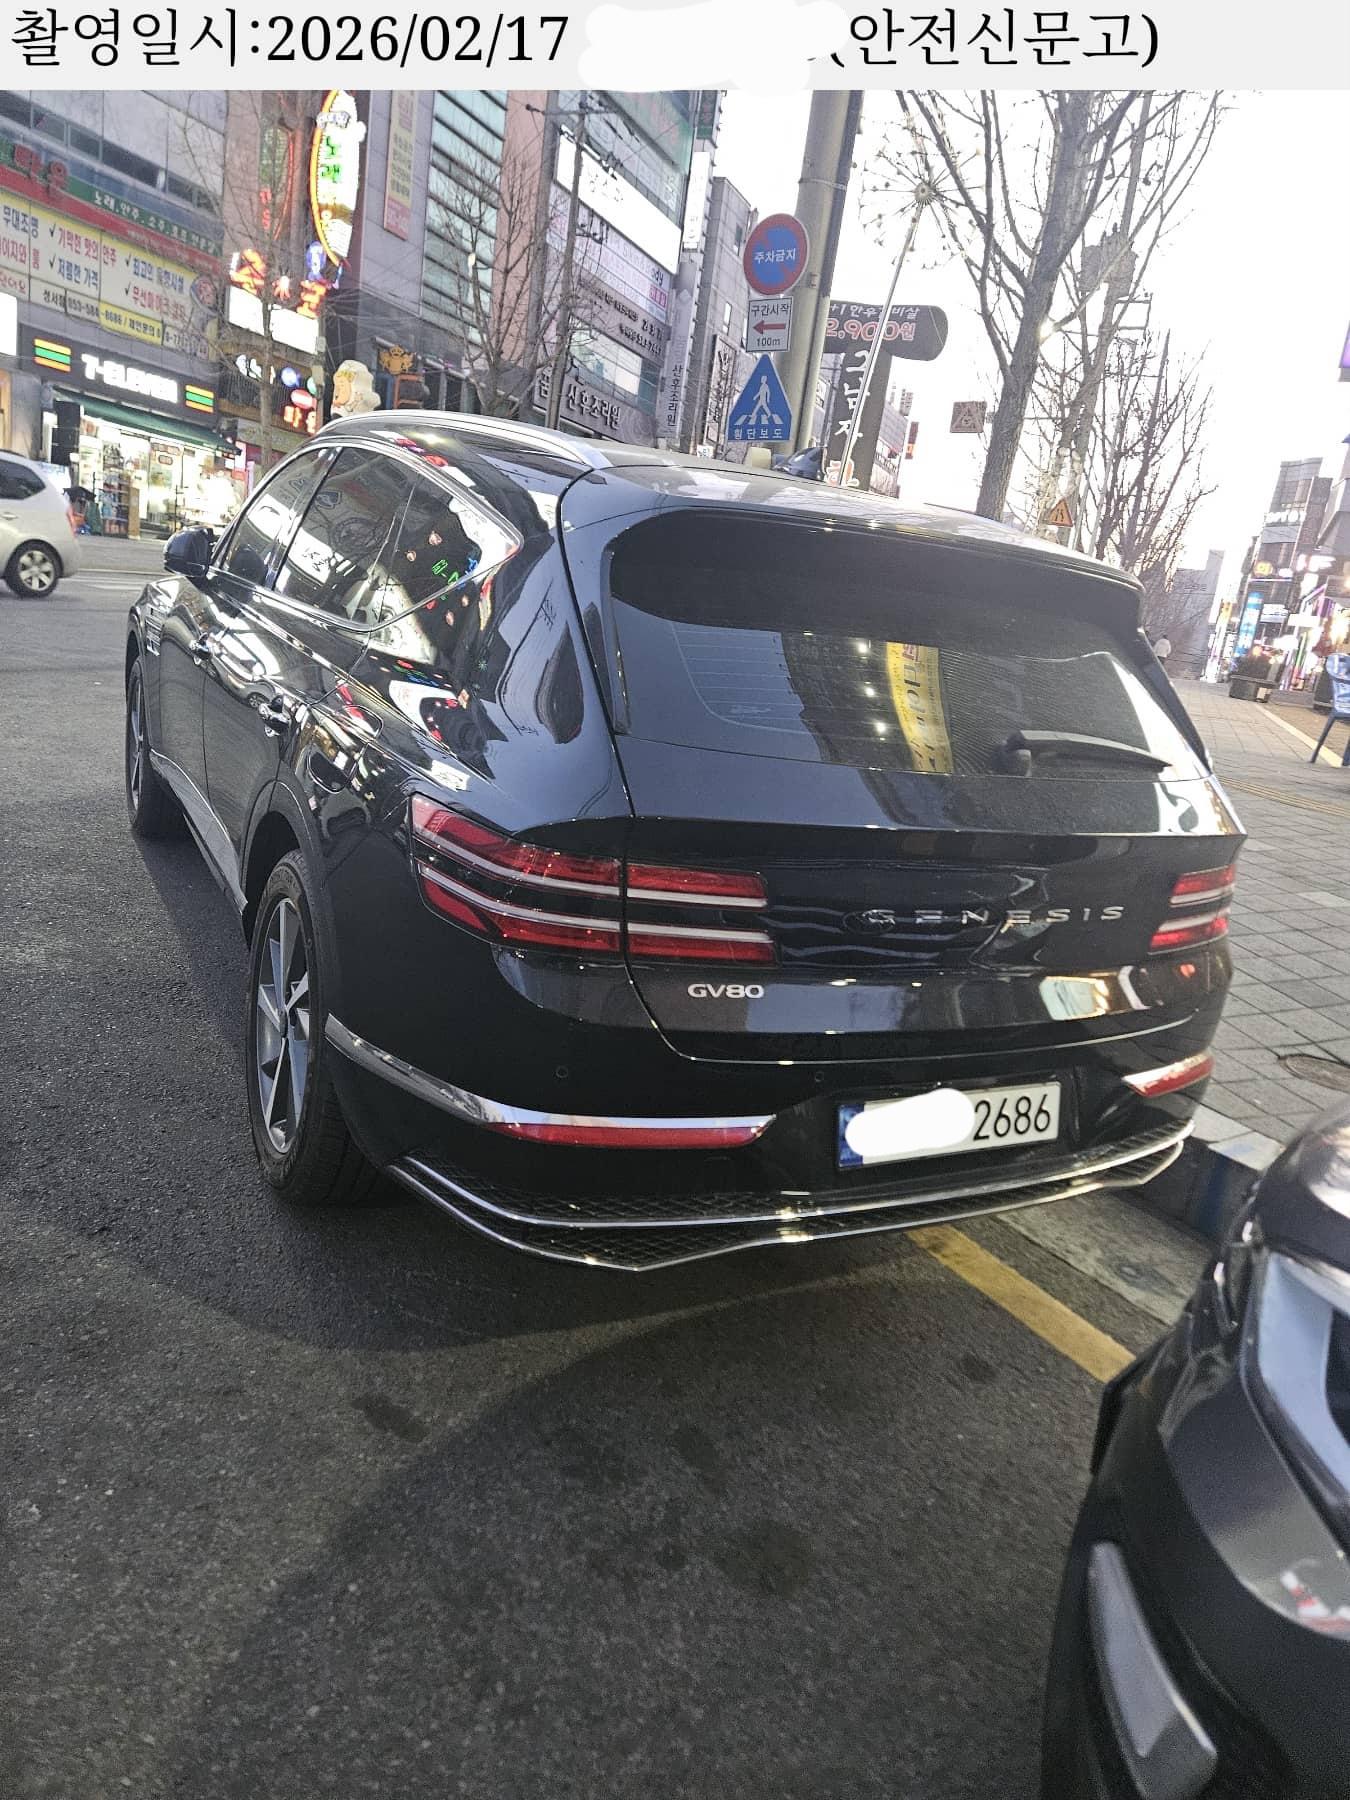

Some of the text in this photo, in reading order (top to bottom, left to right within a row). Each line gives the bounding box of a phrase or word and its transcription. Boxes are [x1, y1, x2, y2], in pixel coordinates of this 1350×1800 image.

[0, 235, 27, 265] 이자와
[753, 247, 797, 264] 주차금지
[750, 302, 791, 318] 구간시작
[756, 336, 781, 348] 100m
[733, 427, 784, 441] 횡단보도
[861, 905, 1125, 927] GENESIS
[686, 982, 765, 1000] GV80
[973, 1093, 1052, 1142] 2686
